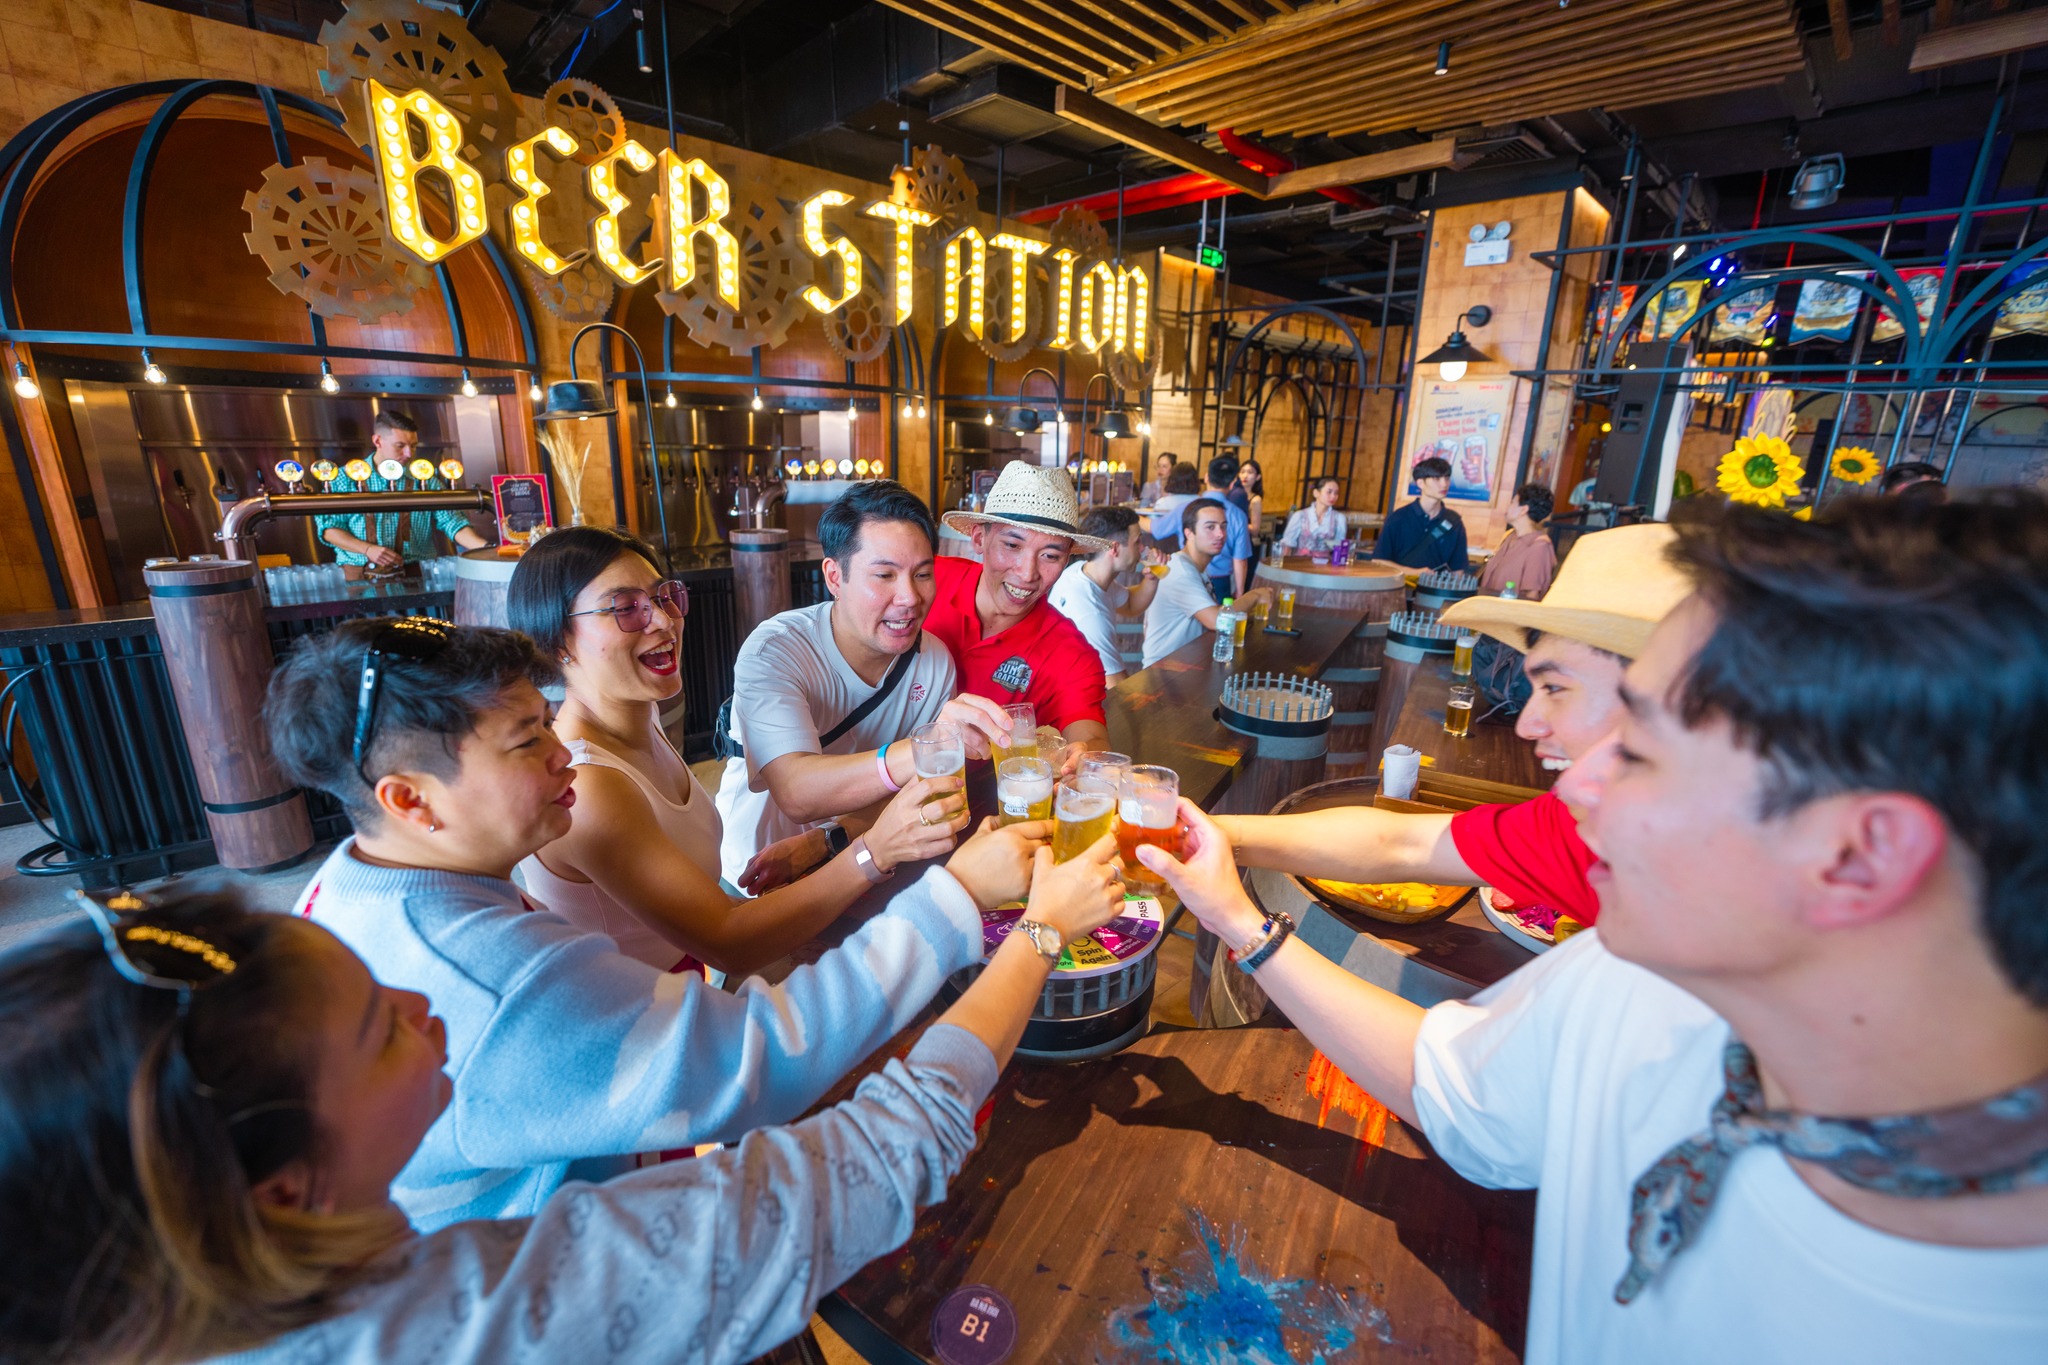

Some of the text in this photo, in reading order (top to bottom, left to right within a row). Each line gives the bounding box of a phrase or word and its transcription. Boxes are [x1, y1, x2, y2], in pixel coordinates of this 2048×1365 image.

[364, 77, 1149, 363] BEER STATION
[992, 669, 1030, 688] KRAFTBER
[1138, 901, 1149, 918] PASS
[1077, 947, 1103, 957] Spin
[1081, 954, 1113, 965] Again
[960, 1313, 990, 1342] B1
